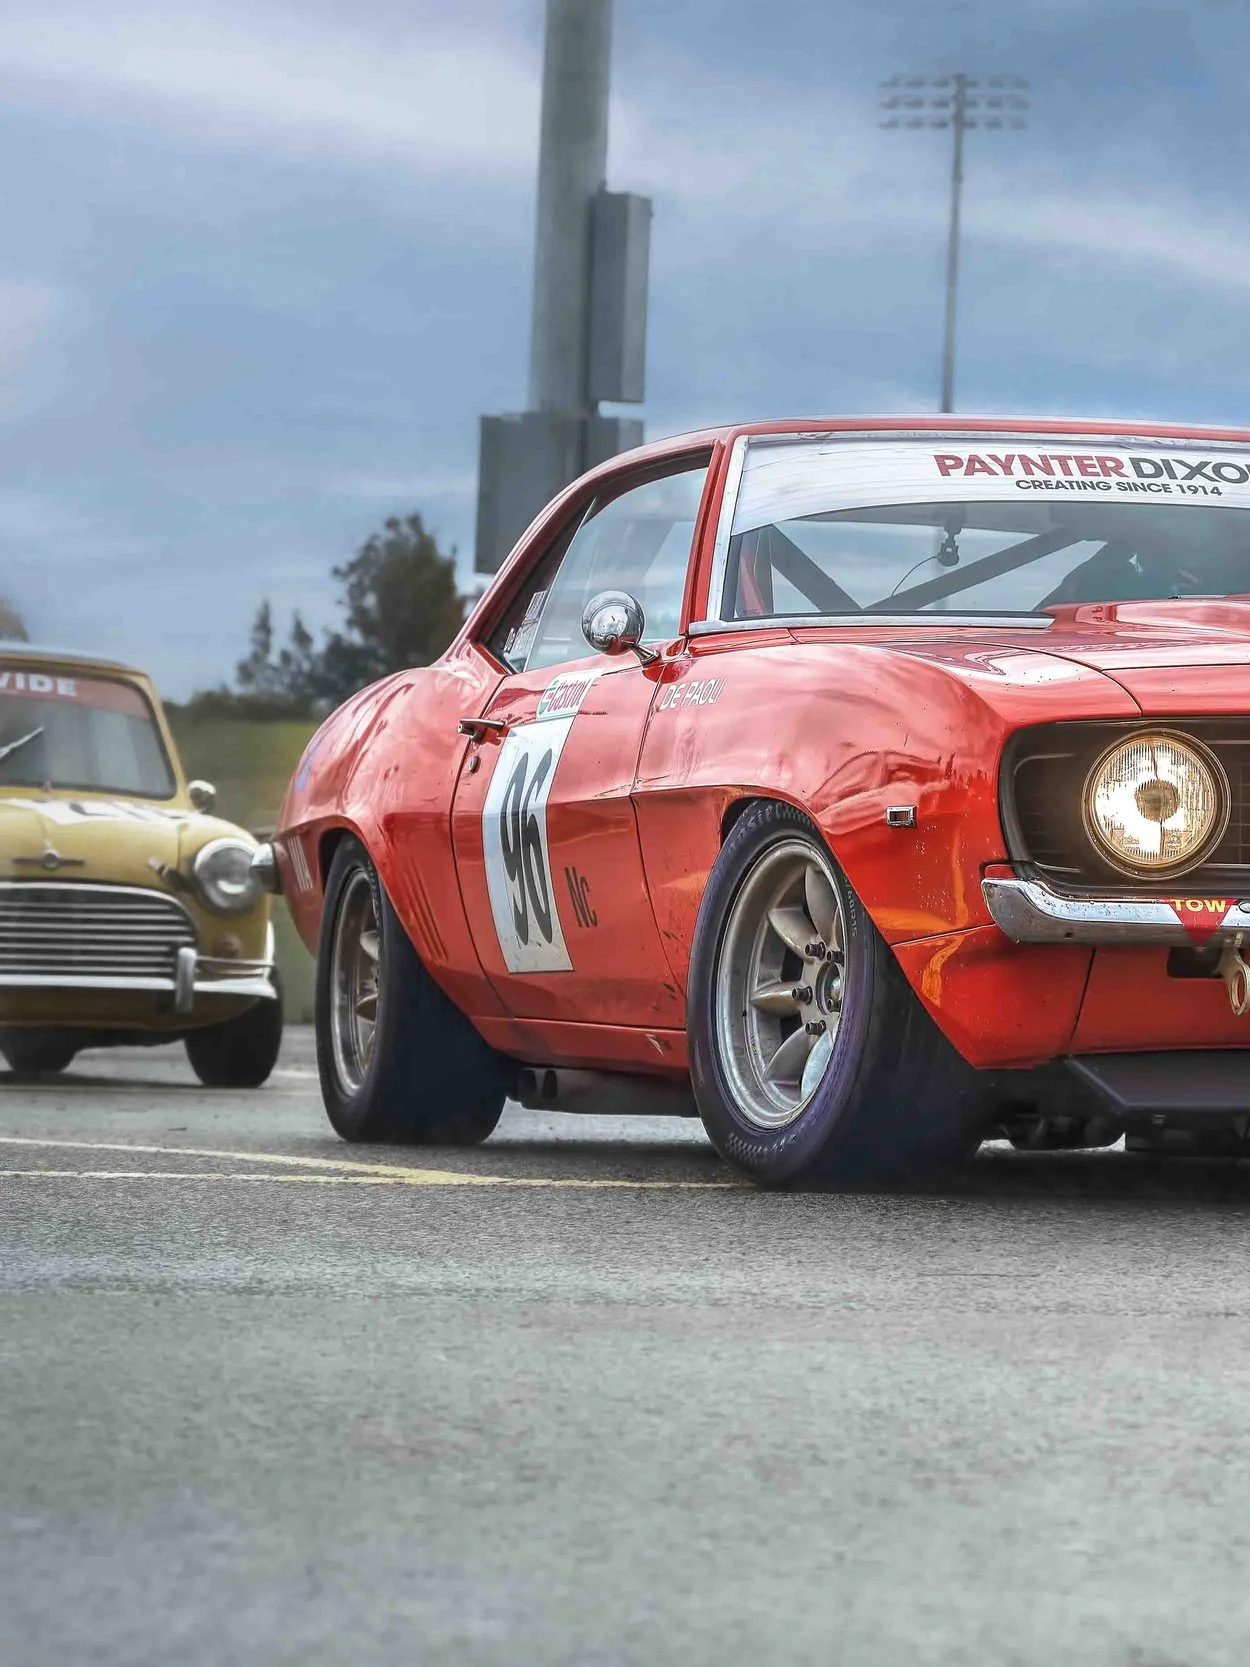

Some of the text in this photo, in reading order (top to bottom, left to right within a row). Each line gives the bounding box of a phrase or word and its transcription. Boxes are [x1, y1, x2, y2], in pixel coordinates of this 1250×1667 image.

[933, 454, 1130, 478] PAYNTER
[1015, 479, 1222, 496] CREATING SINCE 1914
[659, 677, 727, 710] DE PAOLI
[500, 747, 552, 945] 96
[1169, 898, 1227, 913] TOW
